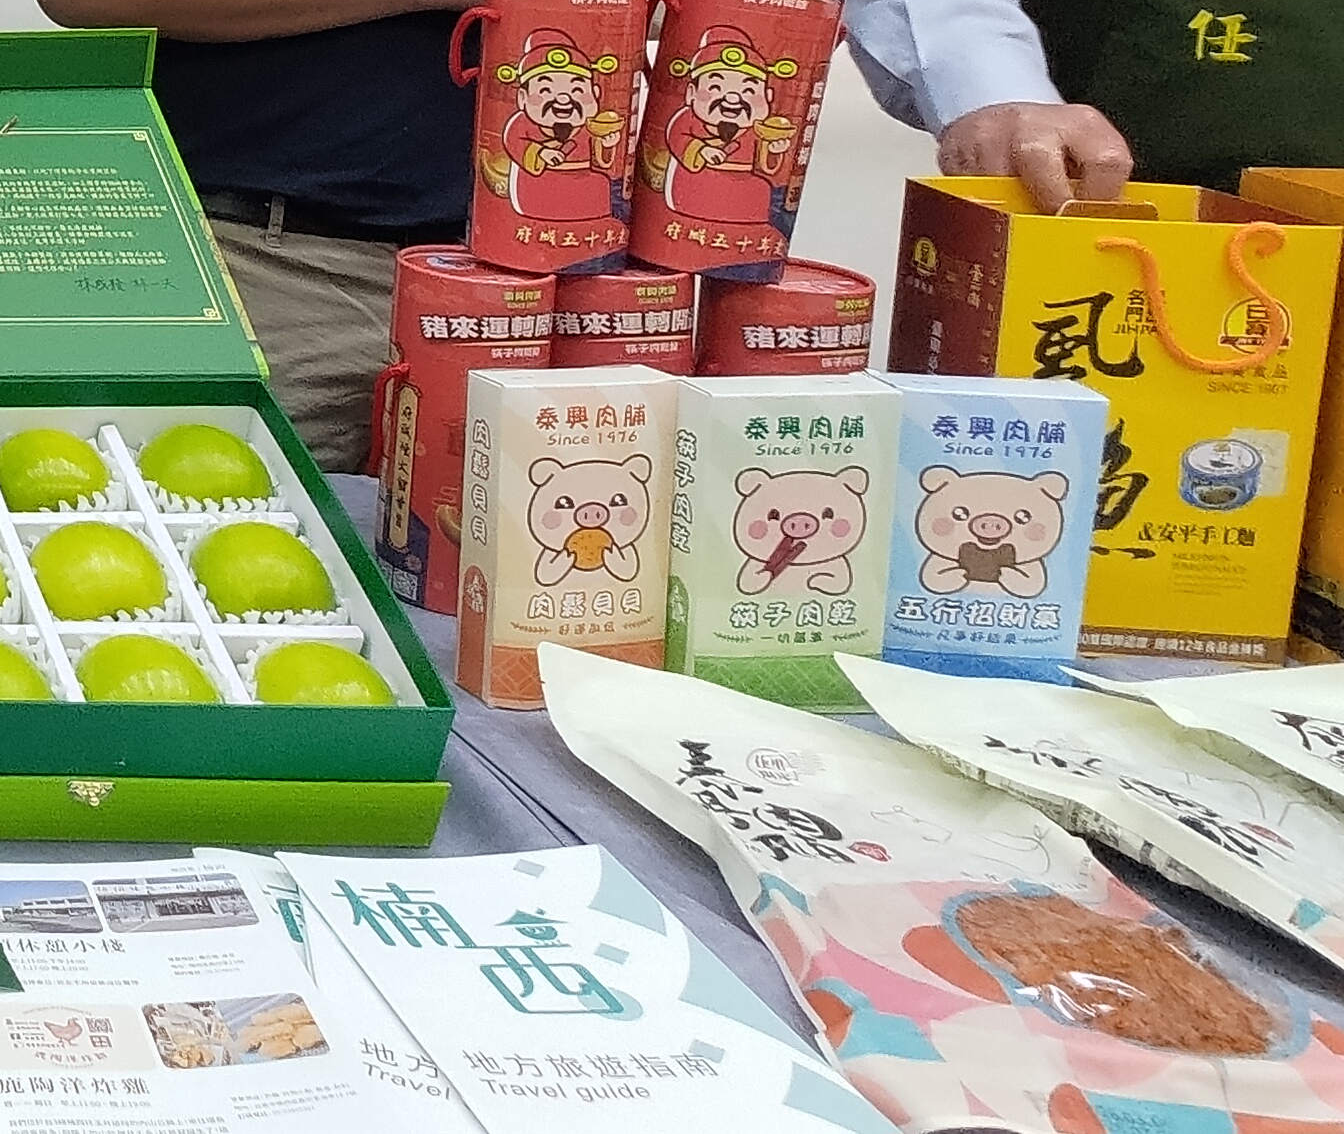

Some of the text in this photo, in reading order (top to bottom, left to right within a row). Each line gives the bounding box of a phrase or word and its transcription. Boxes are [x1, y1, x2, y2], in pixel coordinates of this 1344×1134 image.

[535, 404, 647, 430] 泰興肉脯
[743, 416, 864, 441] 泰興肉脯
[931, 415, 1066, 445] 泰興肉脯
[547, 429, 638, 447] Since 1976
[755, 441, 854, 457] Since 1976
[943, 443, 1053, 460] Since 1976
[527, 588, 642, 619] 肉鬆貝貝
[730, 599, 858, 628] 筷子肉乾
[332, 880, 624, 1014] 楠西
[463, 1050, 720, 1079] 地方旅遊指南
[363, 1063, 451, 1101] Travel
[479, 1077, 651, 1104] Travel guide
